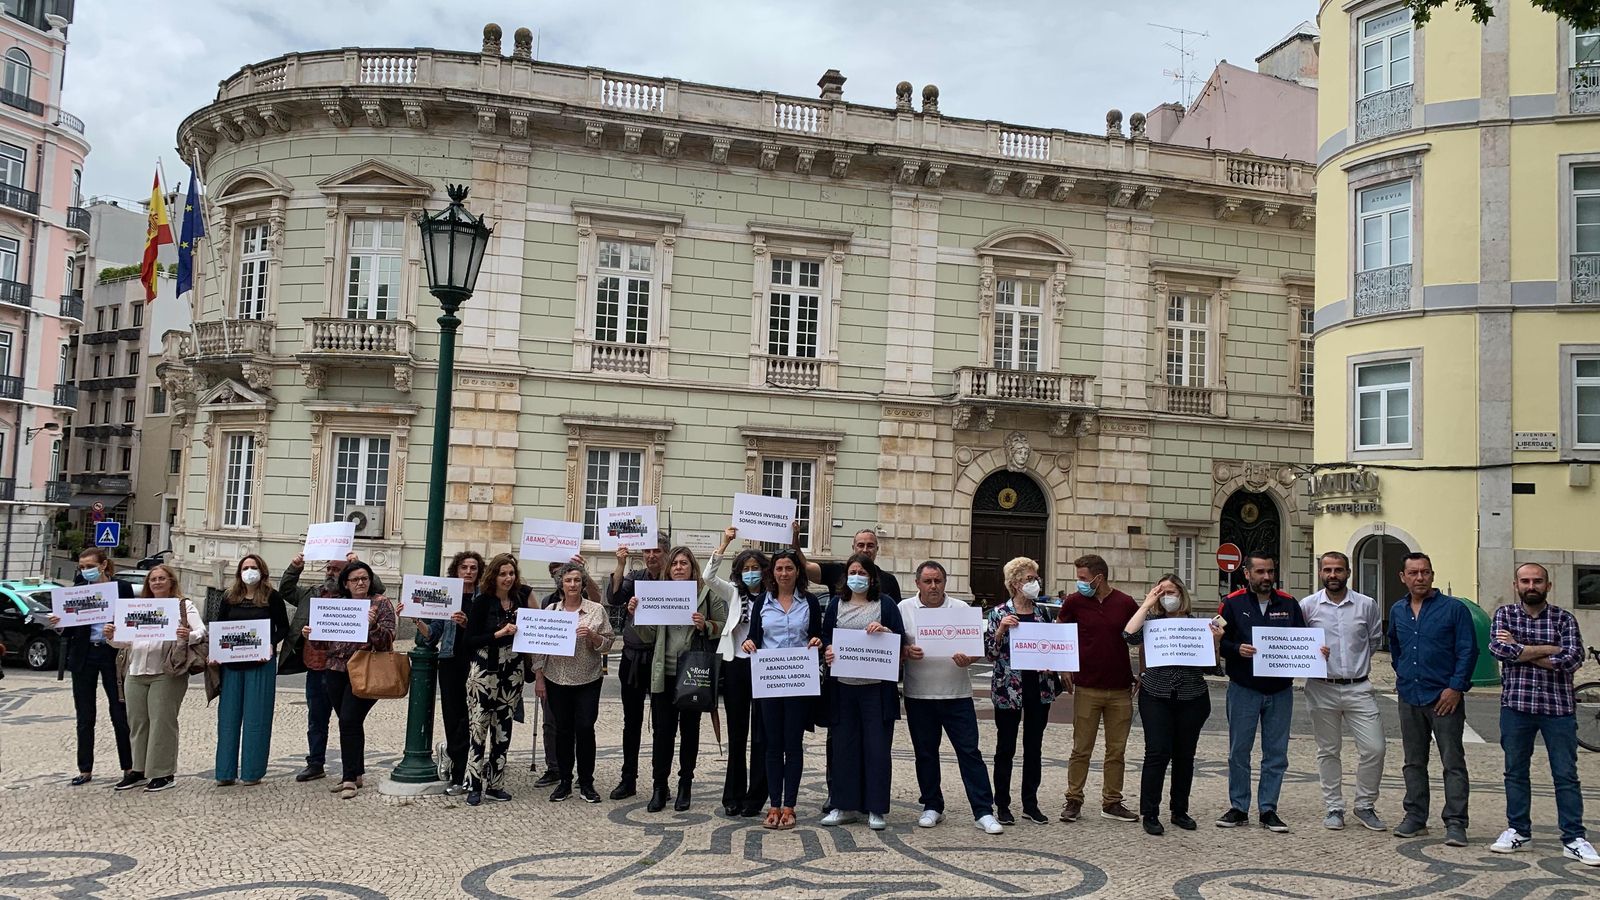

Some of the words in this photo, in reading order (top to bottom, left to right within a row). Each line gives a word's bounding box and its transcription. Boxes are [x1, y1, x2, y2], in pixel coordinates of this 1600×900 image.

[1371, 192, 1402, 203] ATREVIA
[757, 520, 787, 528] INSERVIBLES
[865, 648, 893, 656] INVISIBLES
[859, 656, 892, 664] INSERVIBLES
